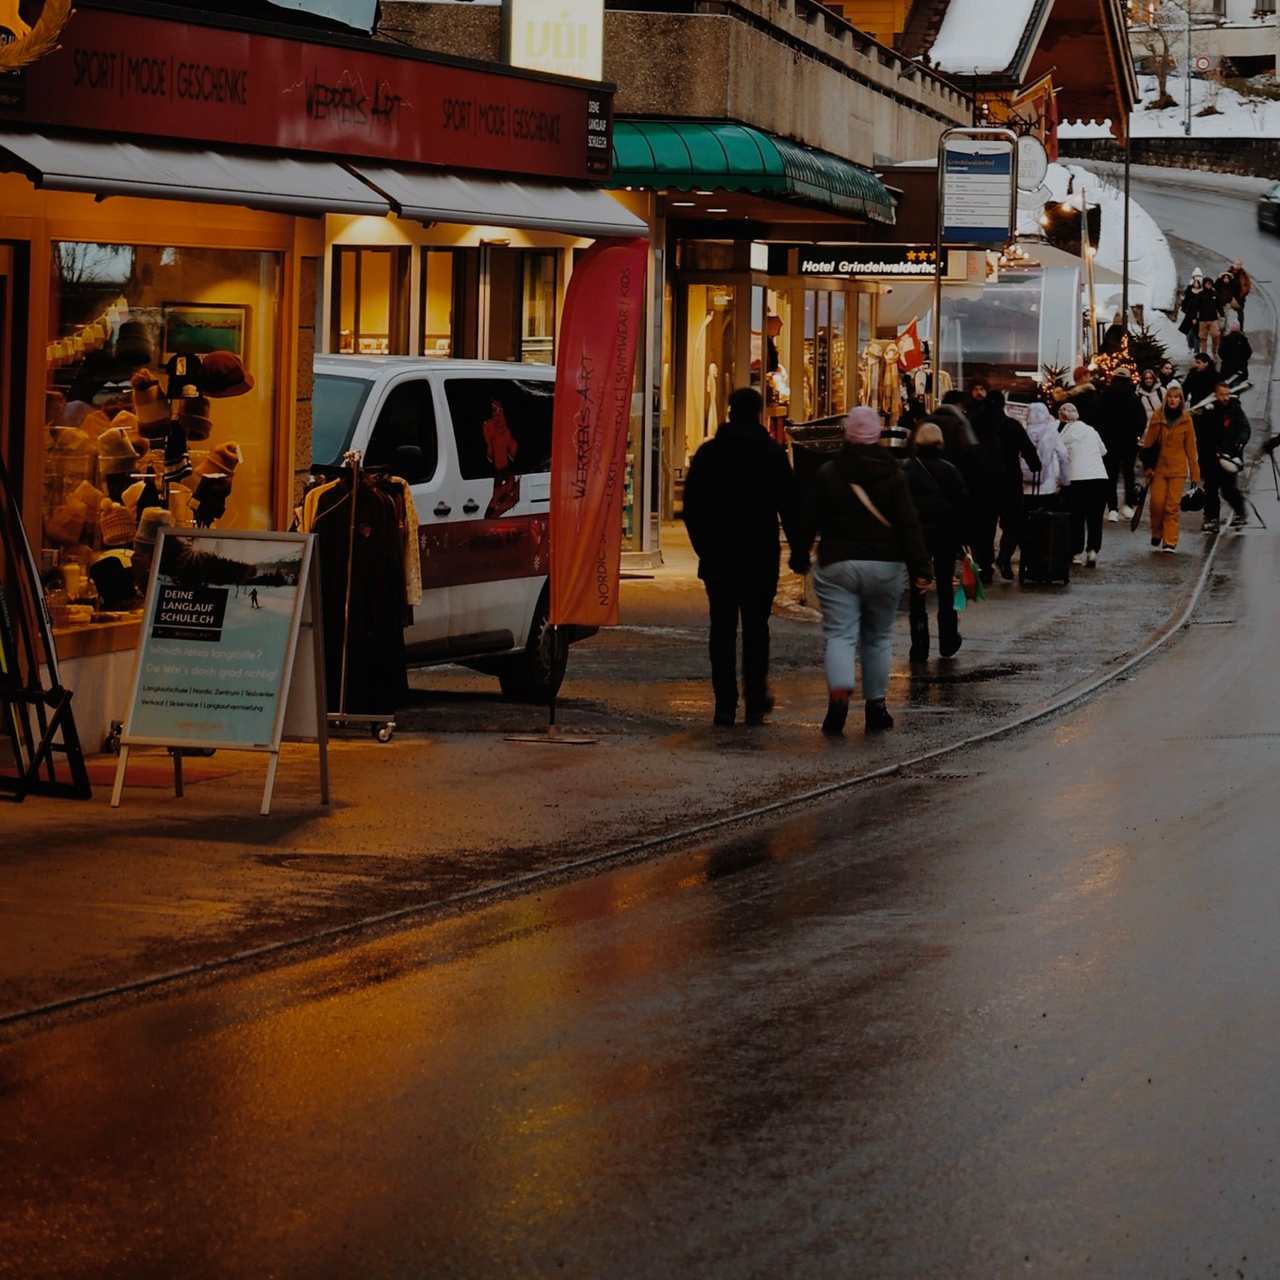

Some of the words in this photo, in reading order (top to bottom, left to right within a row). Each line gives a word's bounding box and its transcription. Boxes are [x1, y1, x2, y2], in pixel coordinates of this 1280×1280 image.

[73, 48, 116, 90] SPORT
[127, 57, 166, 96] MODE
[178, 62, 247, 105] GESCHENKE
[443, 98, 471, 131] SPORT
[479, 102, 506, 136] MODE
[513, 108, 560, 143] GESCHENKE
[801, 261, 834, 272] Hotel
[619, 268, 631, 298] KIDS
[616, 308, 629, 383] SWIMWEAR
[574, 351, 594, 404] ART
[597, 550, 609, 606] NORDIC
[164, 589, 194, 600] DEINE
[162, 601, 214, 613] LANGLAUF
[160, 612, 214, 624] SCHULE.CH
[191, 666, 217, 676] doch
[218, 668, 242, 680] grad
[142, 685, 188, 694] Langlaufschule
[245, 690, 275, 698] Testcenter
[169, 699, 198, 708] Skiservice
[203, 701, 264, 712] Langlaufvermietung
